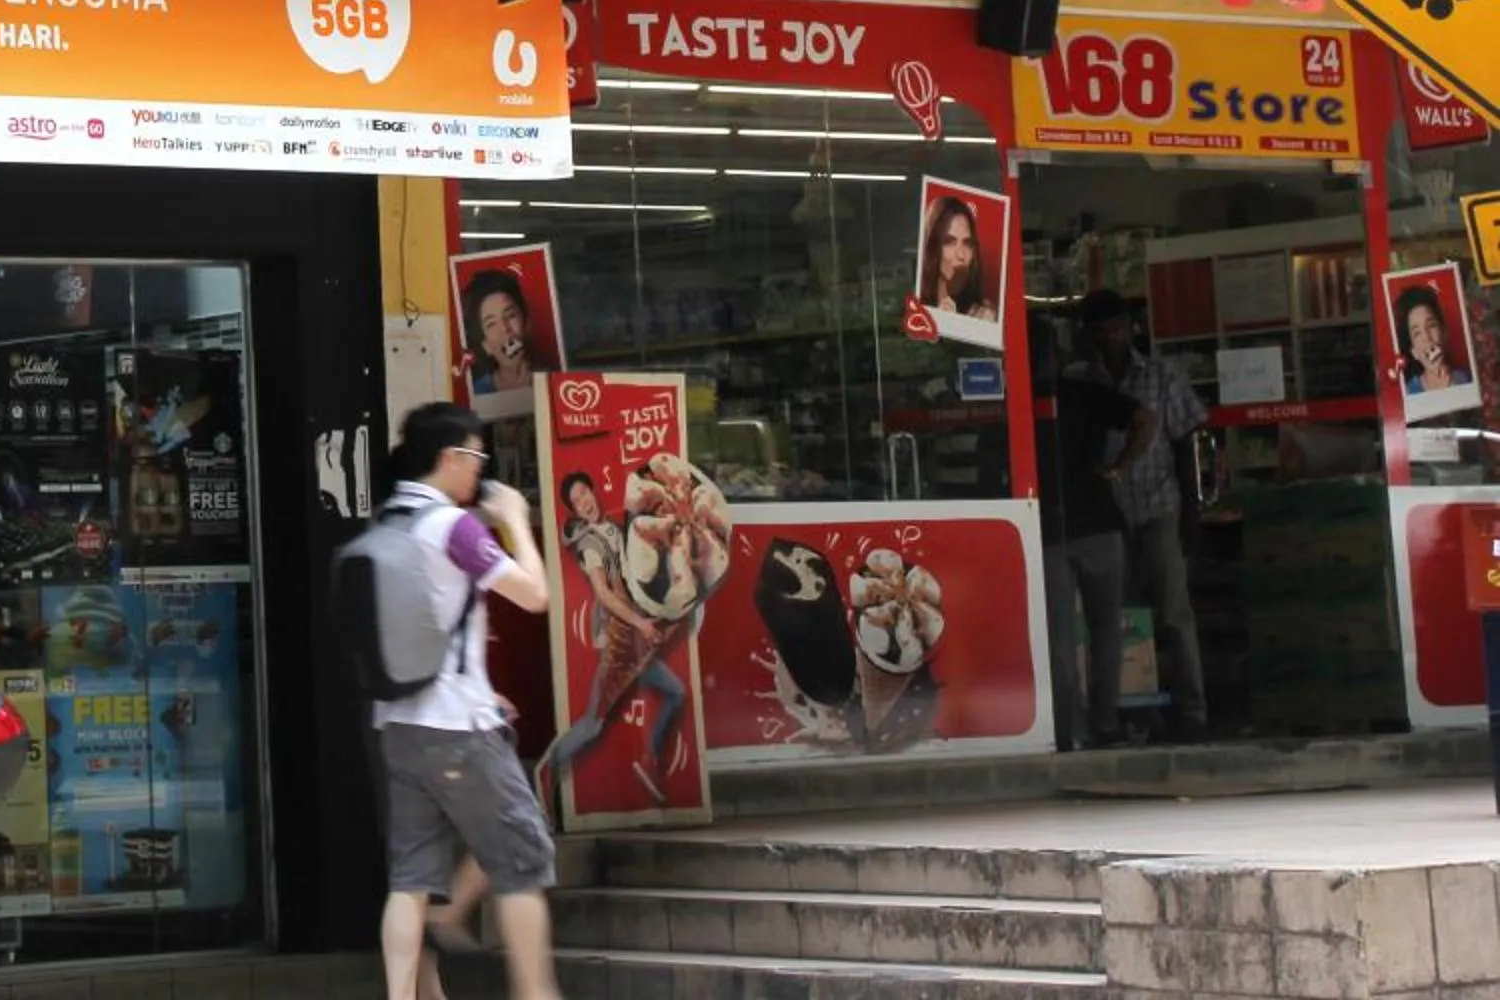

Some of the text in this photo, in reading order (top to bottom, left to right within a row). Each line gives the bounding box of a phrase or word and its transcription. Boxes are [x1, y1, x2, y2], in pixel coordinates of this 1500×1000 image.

[0, 22, 70, 51] HARI.
[627, 12, 866, 66] TASTE JOY
[1305, 38, 1340, 74] 24
[1037, 32, 1176, 121] 168
[1187, 80, 1346, 126] Store
[1415, 104, 1473, 128] WALL'S
[7, 113, 57, 136] astro
[279, 115, 341, 130] dailymotion
[619, 404, 669, 425] TASTE
[624, 424, 669, 452] JOY
[188, 491, 240, 509] FREE
[72, 694, 150, 726] FREE
